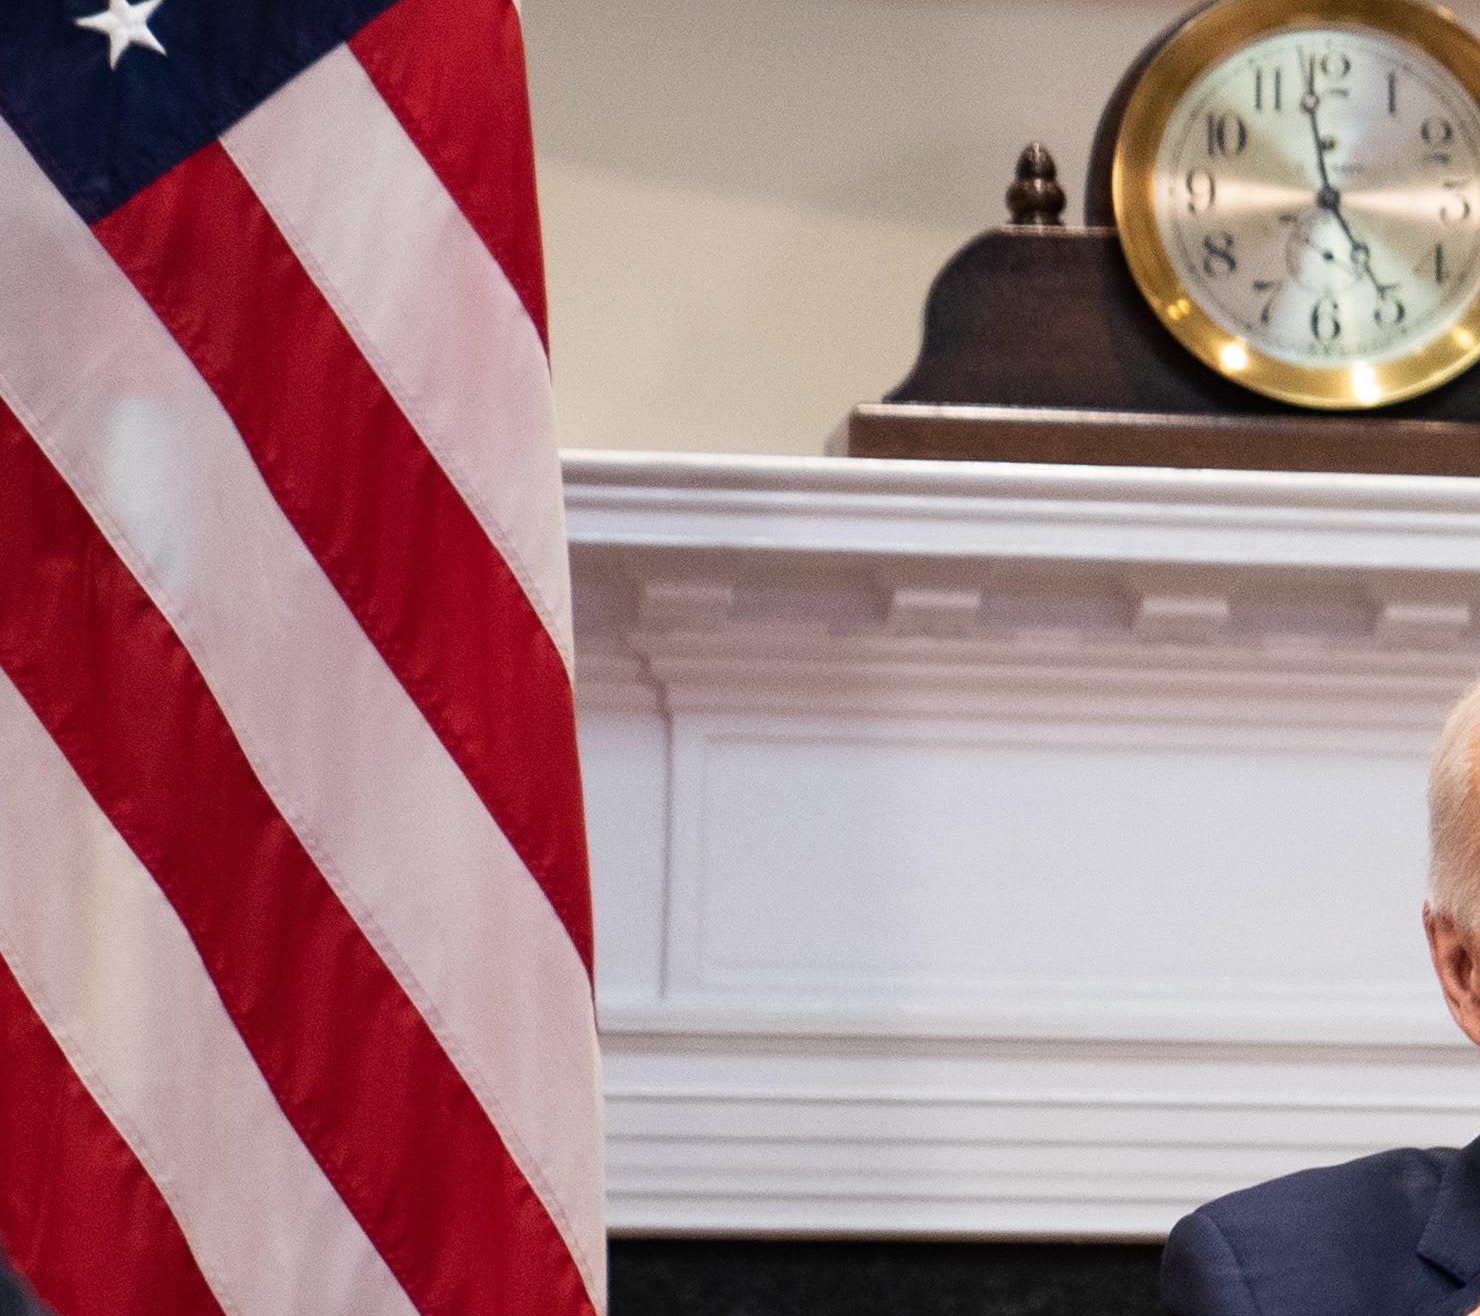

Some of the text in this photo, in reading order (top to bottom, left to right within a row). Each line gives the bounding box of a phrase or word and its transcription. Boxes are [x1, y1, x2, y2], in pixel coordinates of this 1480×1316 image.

[1254, 67, 1282, 111] 11
[1308, 54, 1350, 98] 12
[1387, 71, 1397, 115] 1
[1208, 111, 1247, 158] 10
[1420, 118, 1455, 165] 2
[1185, 166, 1215, 214] 9
[1439, 176, 1472, 225] 3
[1203, 230, 1238, 278] 8
[1414, 242, 1452, 284] 4
[1254, 279, 1279, 326] 7
[1310, 293, 1341, 342] 6
[1373, 283, 1406, 330] 5
